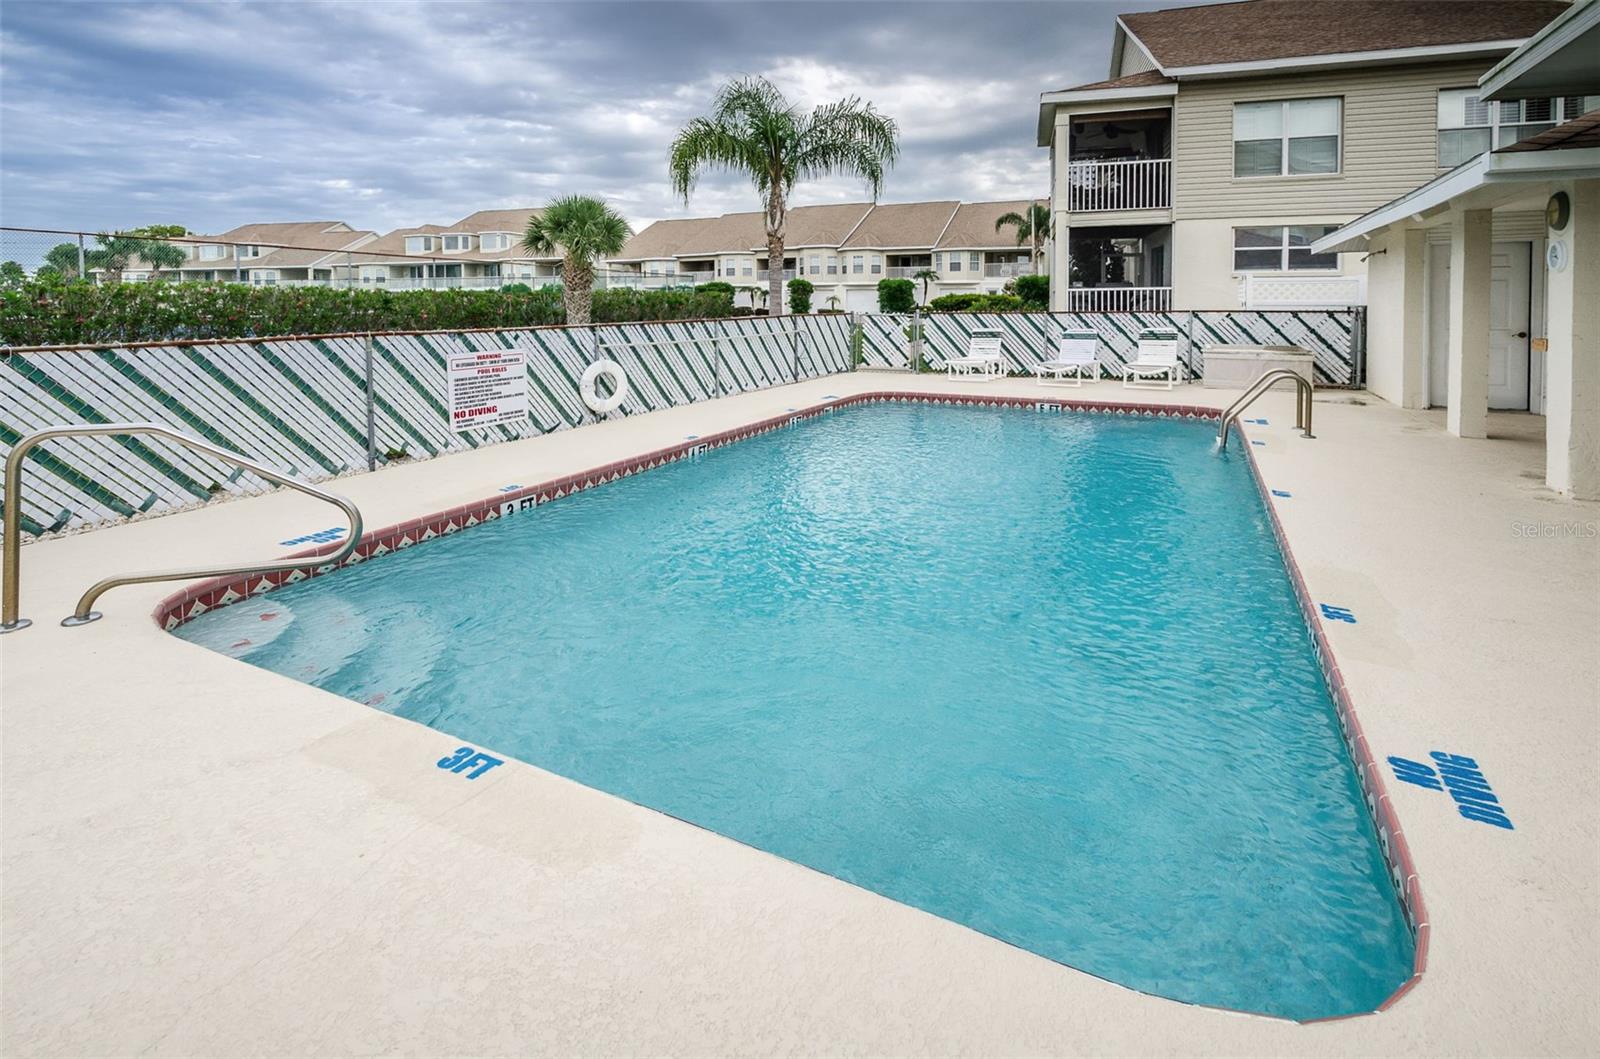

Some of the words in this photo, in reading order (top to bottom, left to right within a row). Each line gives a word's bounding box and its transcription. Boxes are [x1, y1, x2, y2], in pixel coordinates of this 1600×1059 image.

[453, 411, 467, 420] NO
[468, 405, 498, 417] DIVING
[520, 496, 534, 511] FT
[436, 747, 505, 780] 3FT
[1428, 750, 1514, 830] DIVING
